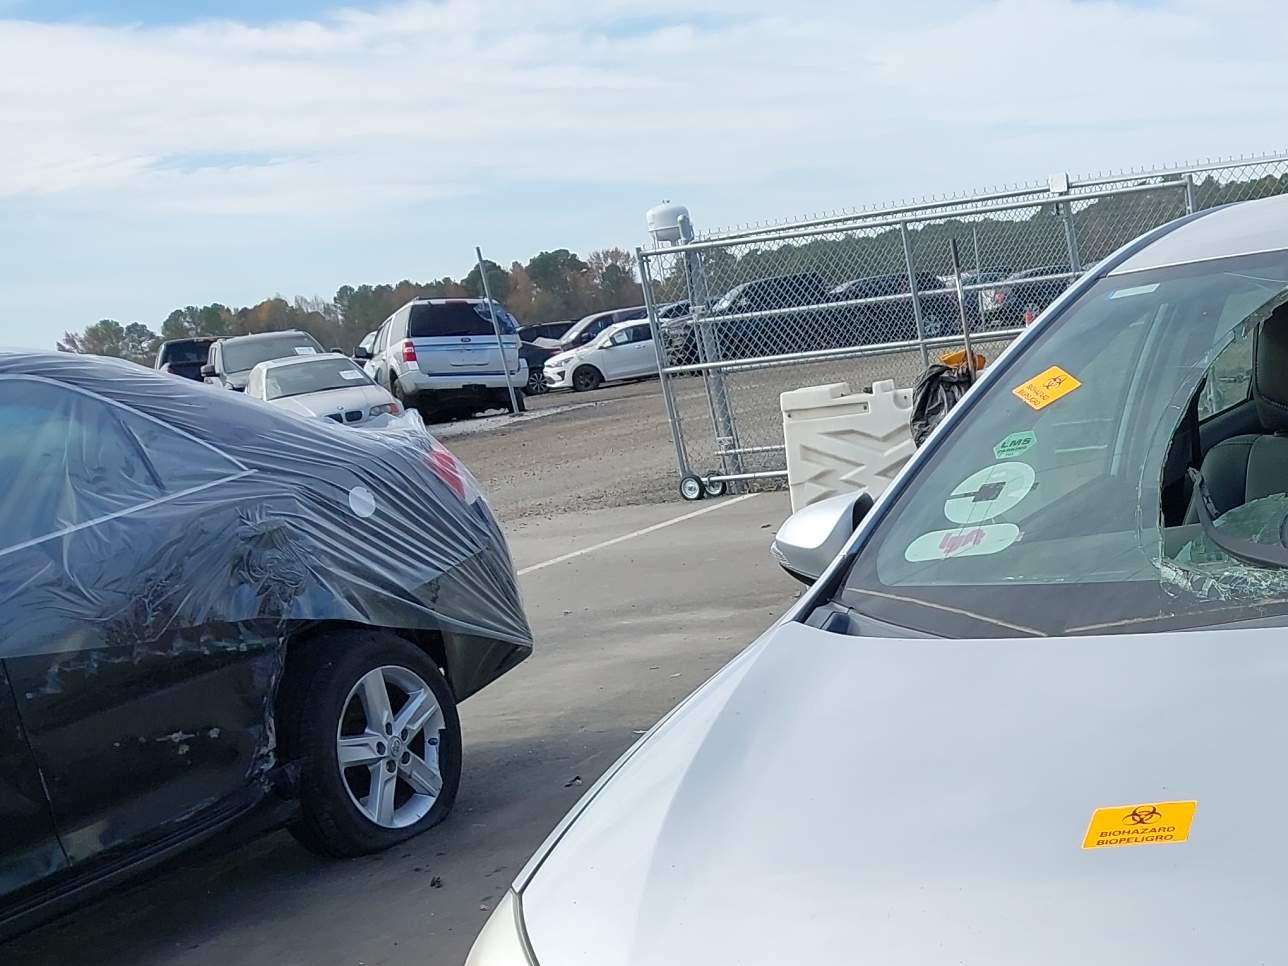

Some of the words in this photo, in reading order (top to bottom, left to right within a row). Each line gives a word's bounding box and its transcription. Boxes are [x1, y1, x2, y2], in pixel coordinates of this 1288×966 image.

[1000, 437, 1033, 449] LMS
[1099, 826, 1175, 837] BIOHAZARD
[1096, 834, 1174, 846] BIOPELIGRO
